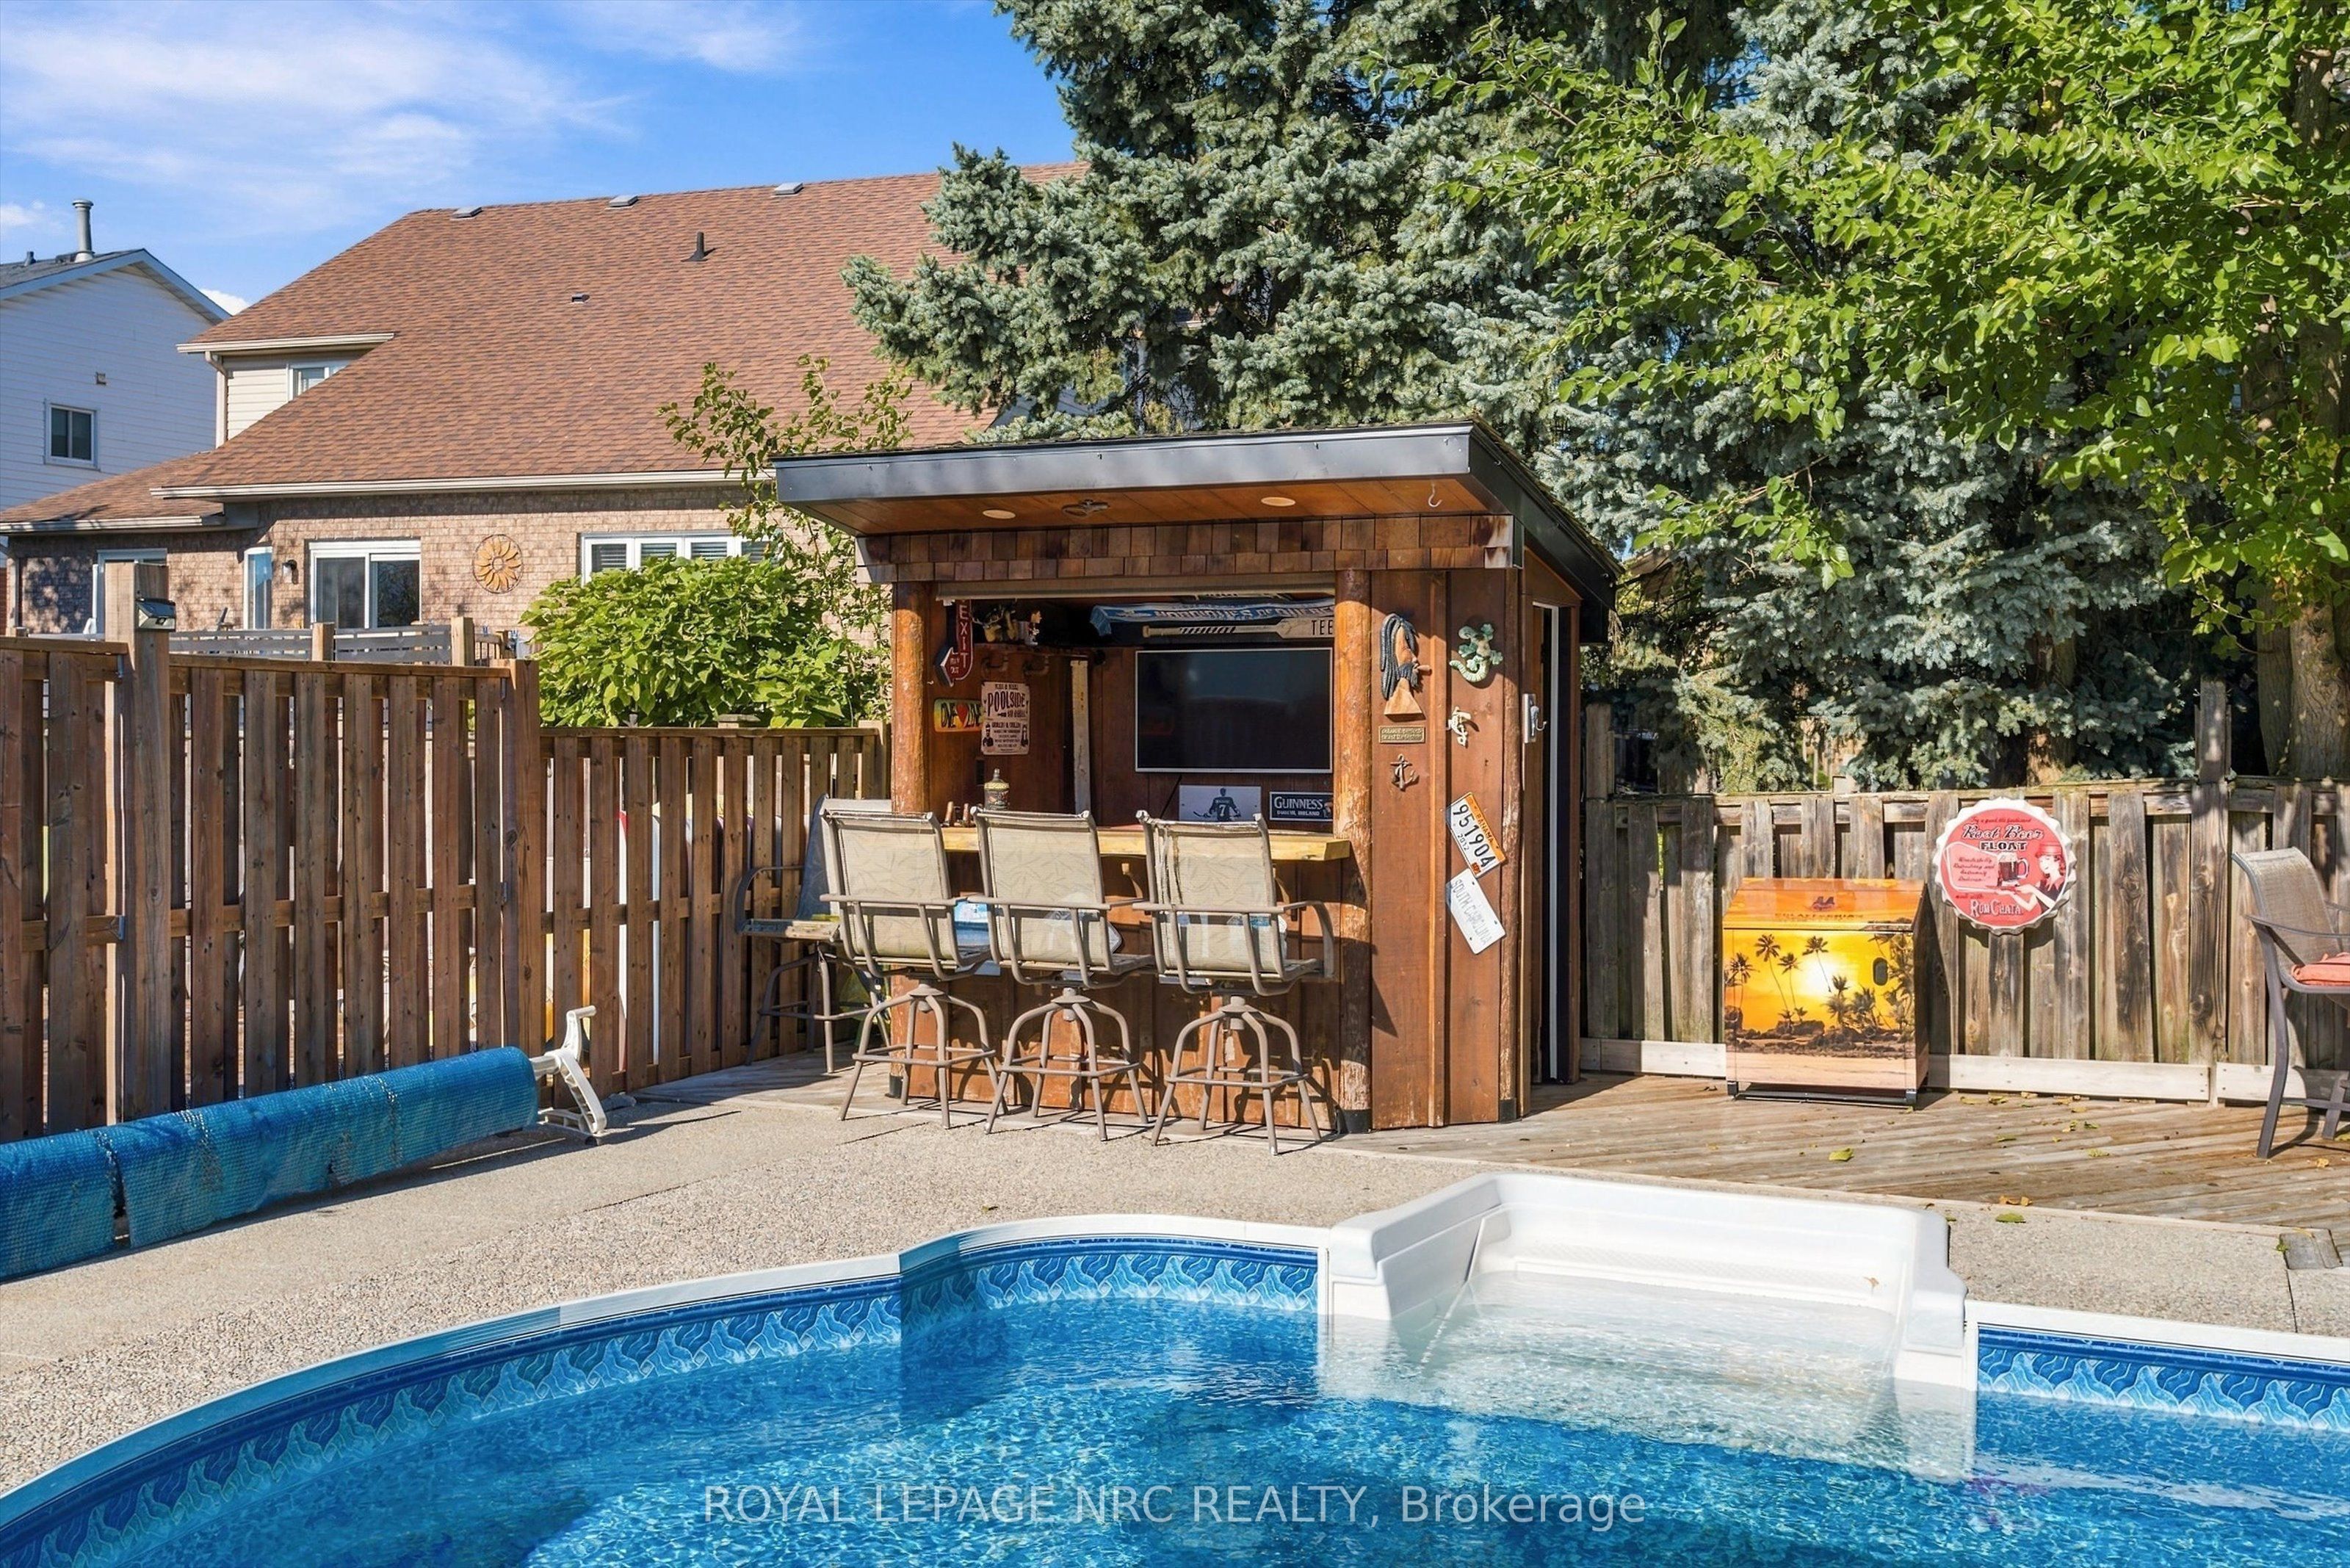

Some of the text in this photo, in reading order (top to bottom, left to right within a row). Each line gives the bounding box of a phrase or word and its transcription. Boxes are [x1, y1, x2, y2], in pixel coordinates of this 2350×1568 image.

[959, 604, 969, 668] EXIT
[988, 690, 1026, 717] POOLSIDE
[1219, 804, 1226, 817] 7
[1273, 796, 1323, 810] GUINNESS
[1453, 803, 1496, 867] 951904
[1476, 813, 1495, 843] PANAMA
[1962, 823, 2044, 841] Root Beer
[1457, 833, 1470, 851] 2012
[1980, 841, 2028, 851] FLOAT
[1451, 879, 1493, 945] SOUTH CAROLINA
